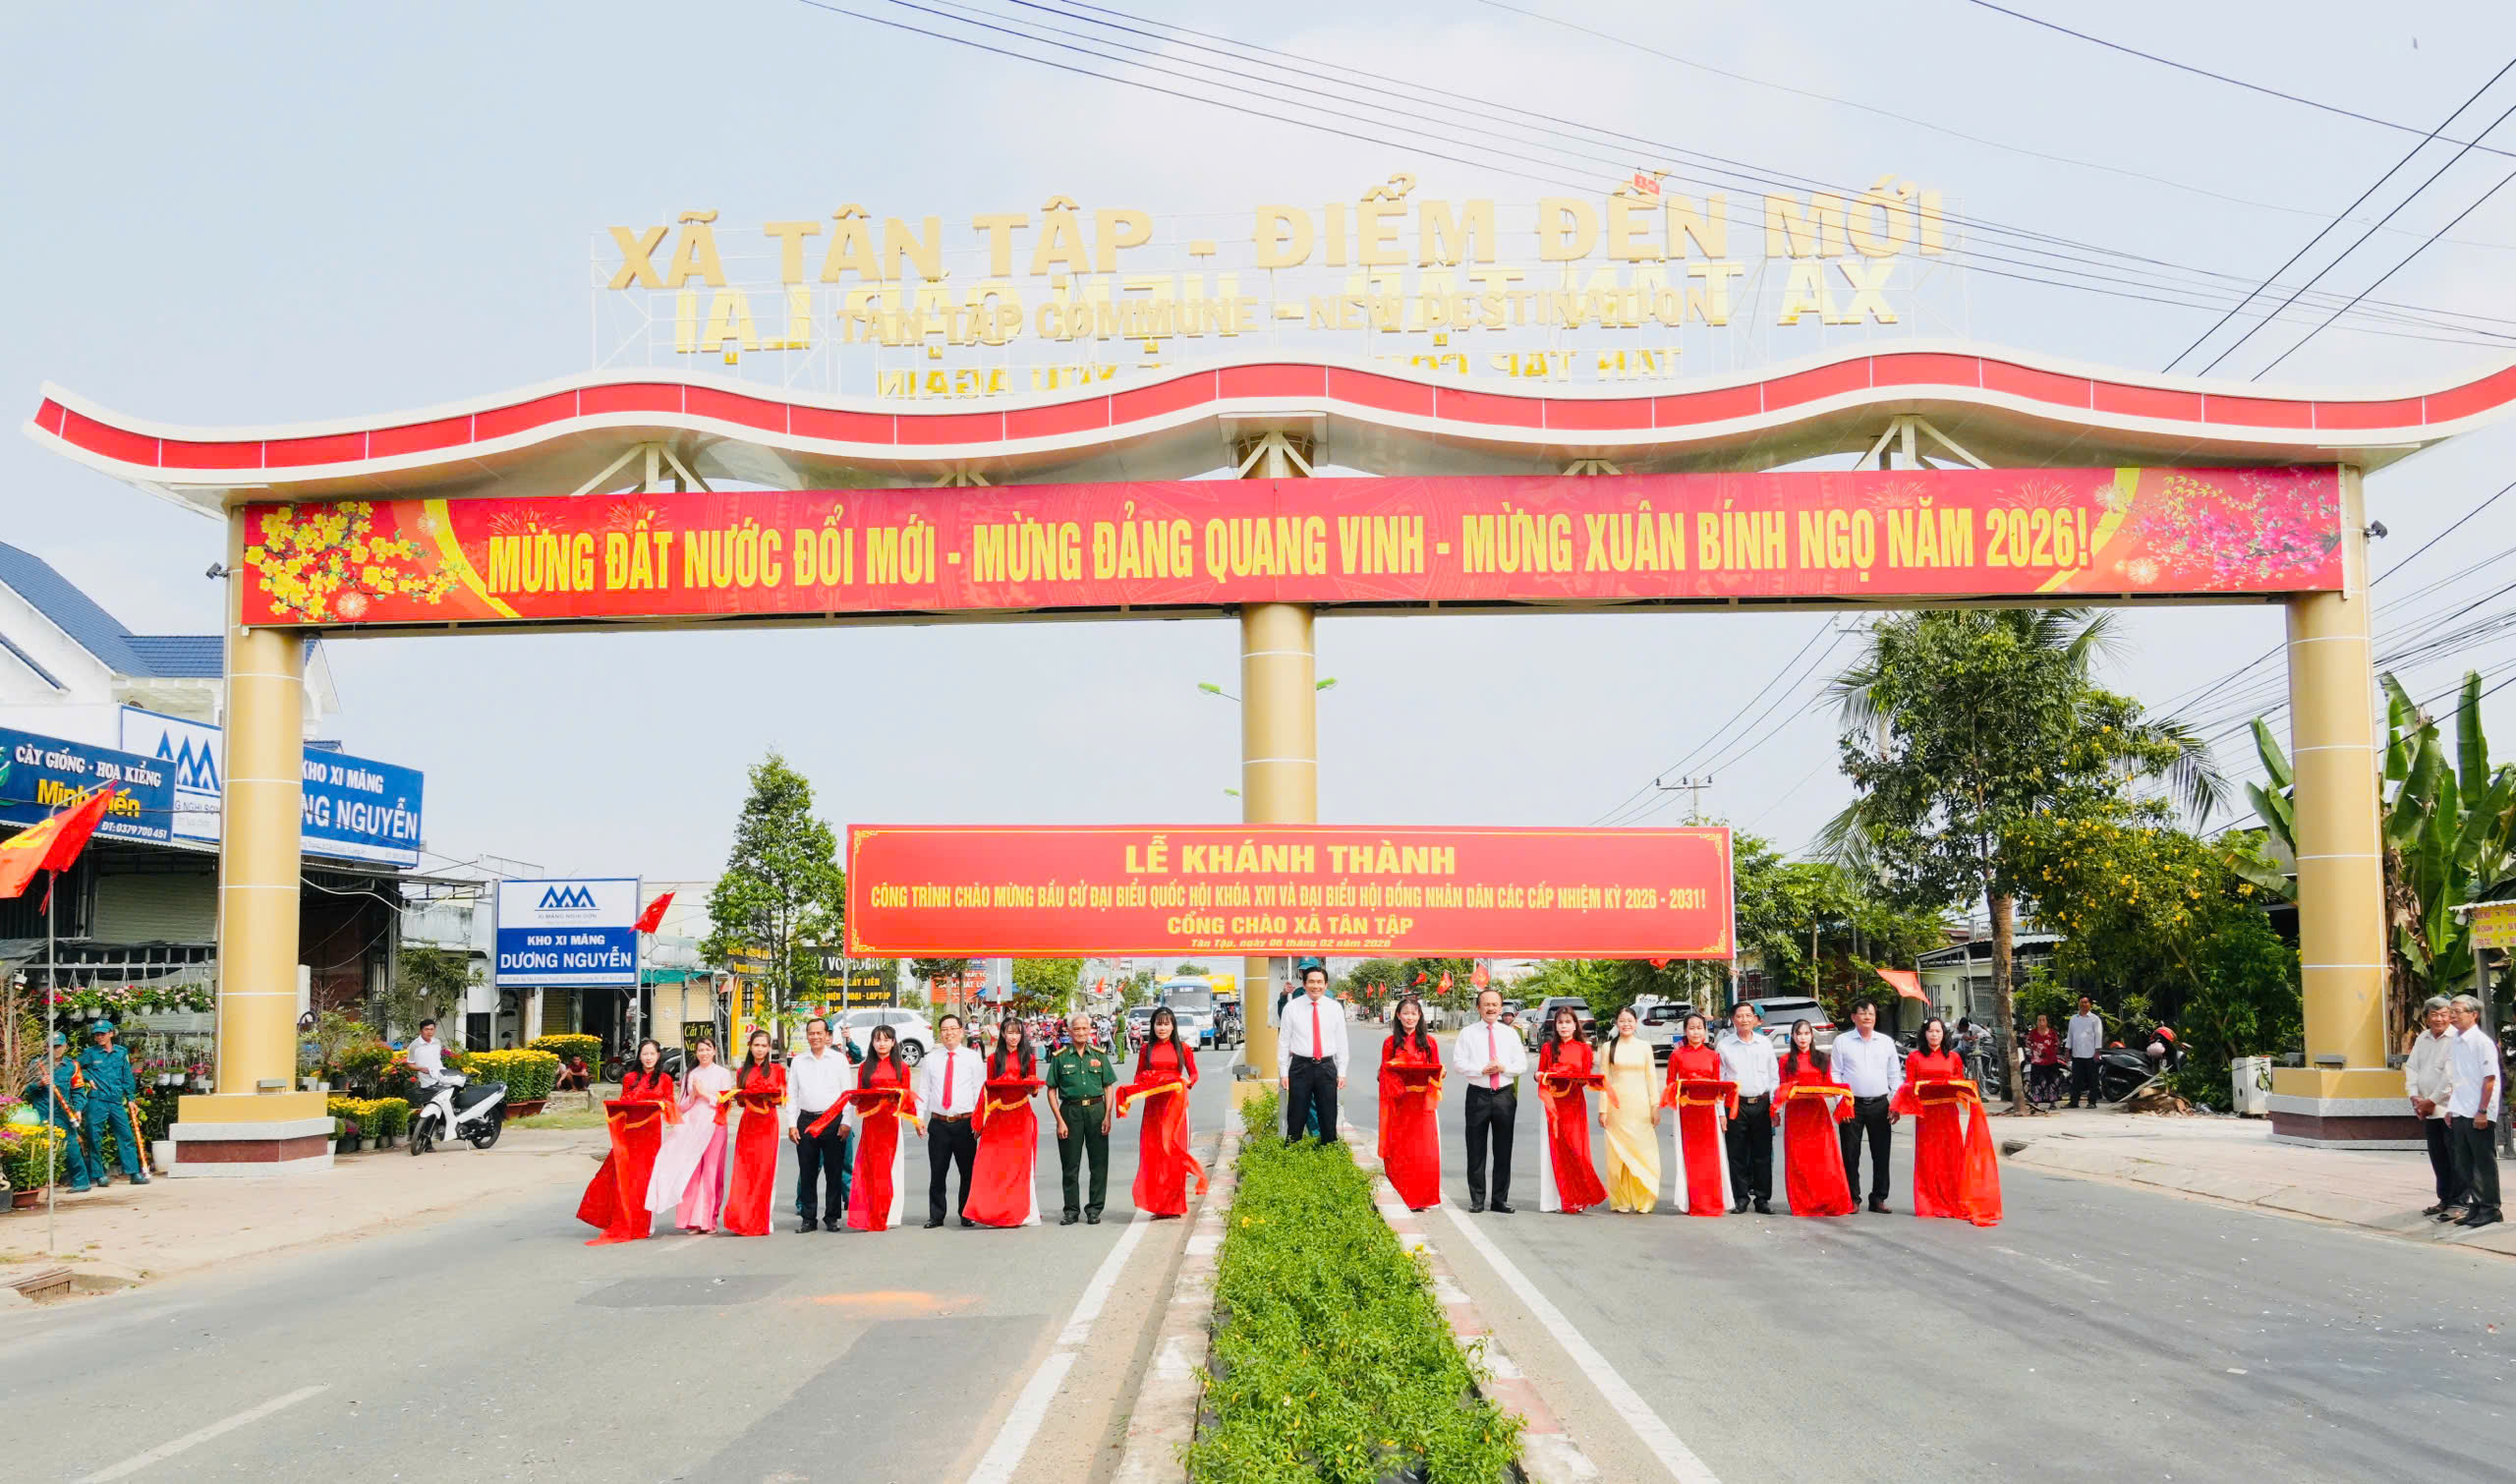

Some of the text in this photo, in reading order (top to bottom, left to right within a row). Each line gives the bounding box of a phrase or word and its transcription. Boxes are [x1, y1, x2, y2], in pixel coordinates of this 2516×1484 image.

[607, 169, 1952, 290] XÃ TÂN TẬP - ĐIỂM ĐẾN MỚI
[836, 306, 925, 345] TAN
[1035, 297, 1259, 339] COMMUNE
[1309, 292, 1404, 331] NEW
[1423, 286, 1716, 328] DESTINATION
[487, 495, 2088, 594] MỪNG ĐẤT NƯỚC ĐỔI MỚI - MỪNG ĐẢNG QUANG VINH - MỪNG XUÂN BÍNH NGỌ NĂM 2026!
[15, 743, 43, 765] CÂY
[45, 748, 86, 773] GIỐNG
[95, 761, 121, 780] HOA
[125, 761, 161, 787] KIỂNG
[302, 760, 383, 794] KHO XI MĂNG
[37, 778, 141, 818] Minh iến
[336, 797, 417, 840] NGUYỄN
[1125, 834, 1456, 874] LỄ KHÁNH THÀNH
[871, 882, 908, 908] CÔNG
[911, 882, 951, 908] TRÌNH
[954, 882, 990, 908] CHÀO
[994, 881, 1034, 908] MỪNG
[1038, 879, 1064, 907] BẦU
[1068, 880, 1087, 907] CỬ
[1090, 886, 1113, 912] ĐẠI
[1116, 878, 1147, 907] BIỂU
[1150, 879, 1185, 909] QUỐC
[1189, 882, 1212, 911] HỘI
[1215, 882, 1250, 907] KHÓA
[1254, 885, 1276, 907] XVI
[1279, 882, 1296, 906] VÀ
[1299, 885, 1322, 911] ĐẠI
[1326, 878, 1355, 907] BIỂU
[1359, 882, 1382, 912] HỘI
[1385, 880, 1422, 907] ĐỒNG
[1425, 883, 1462, 908] NHÂN
[1466, 883, 1494, 908] DÂN
[1498, 883, 1523, 908] CÁC
[1527, 881, 1554, 908] CẤP
[1558, 884, 1601, 913] NHIỆM
[1604, 884, 1622, 908] KỲ
[1625, 887, 1657, 909] 2026
[1669, 888, 1706, 909] 2031!
[528, 934, 605, 946] KHO XI MĂNG
[1168, 910, 1413, 939] CỔNG CHÀO XÃ TÂN TẬP
[500, 945, 632, 969] DƯƠNG NGUYỄN
